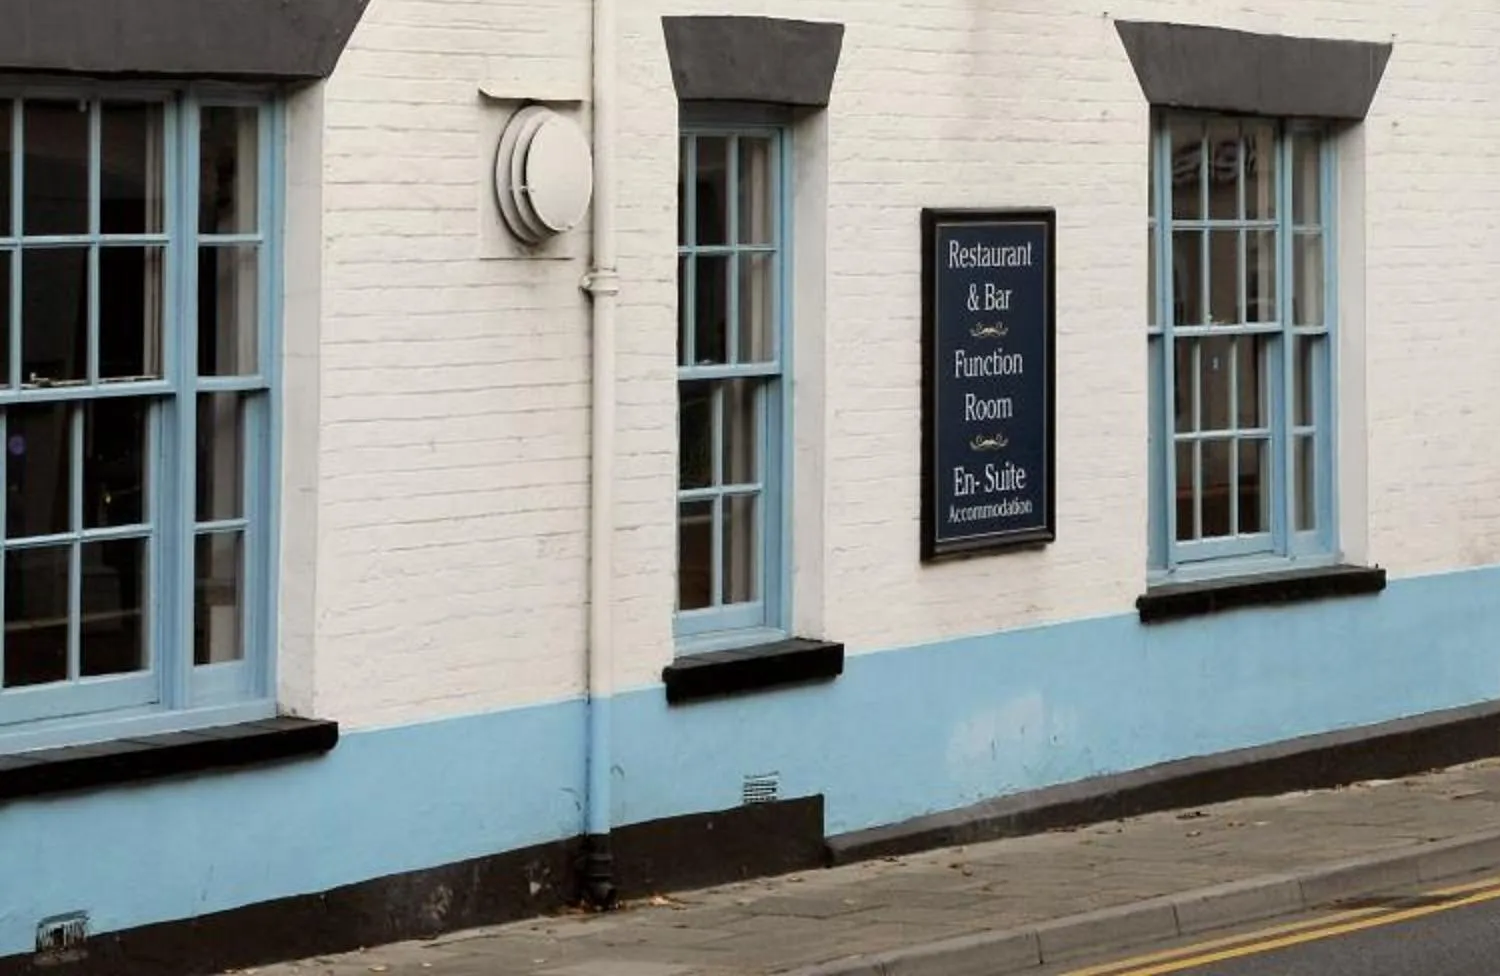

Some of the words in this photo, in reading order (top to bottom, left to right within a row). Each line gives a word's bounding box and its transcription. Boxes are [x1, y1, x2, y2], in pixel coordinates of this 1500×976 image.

[949, 239, 1032, 268] Restaurant
[967, 284, 979, 312] &
[985, 282, 1012, 311] Bar
[955, 347, 1023, 378] Function
[965, 393, 1013, 421] Room
[949, 497, 1033, 523] Accommodation
